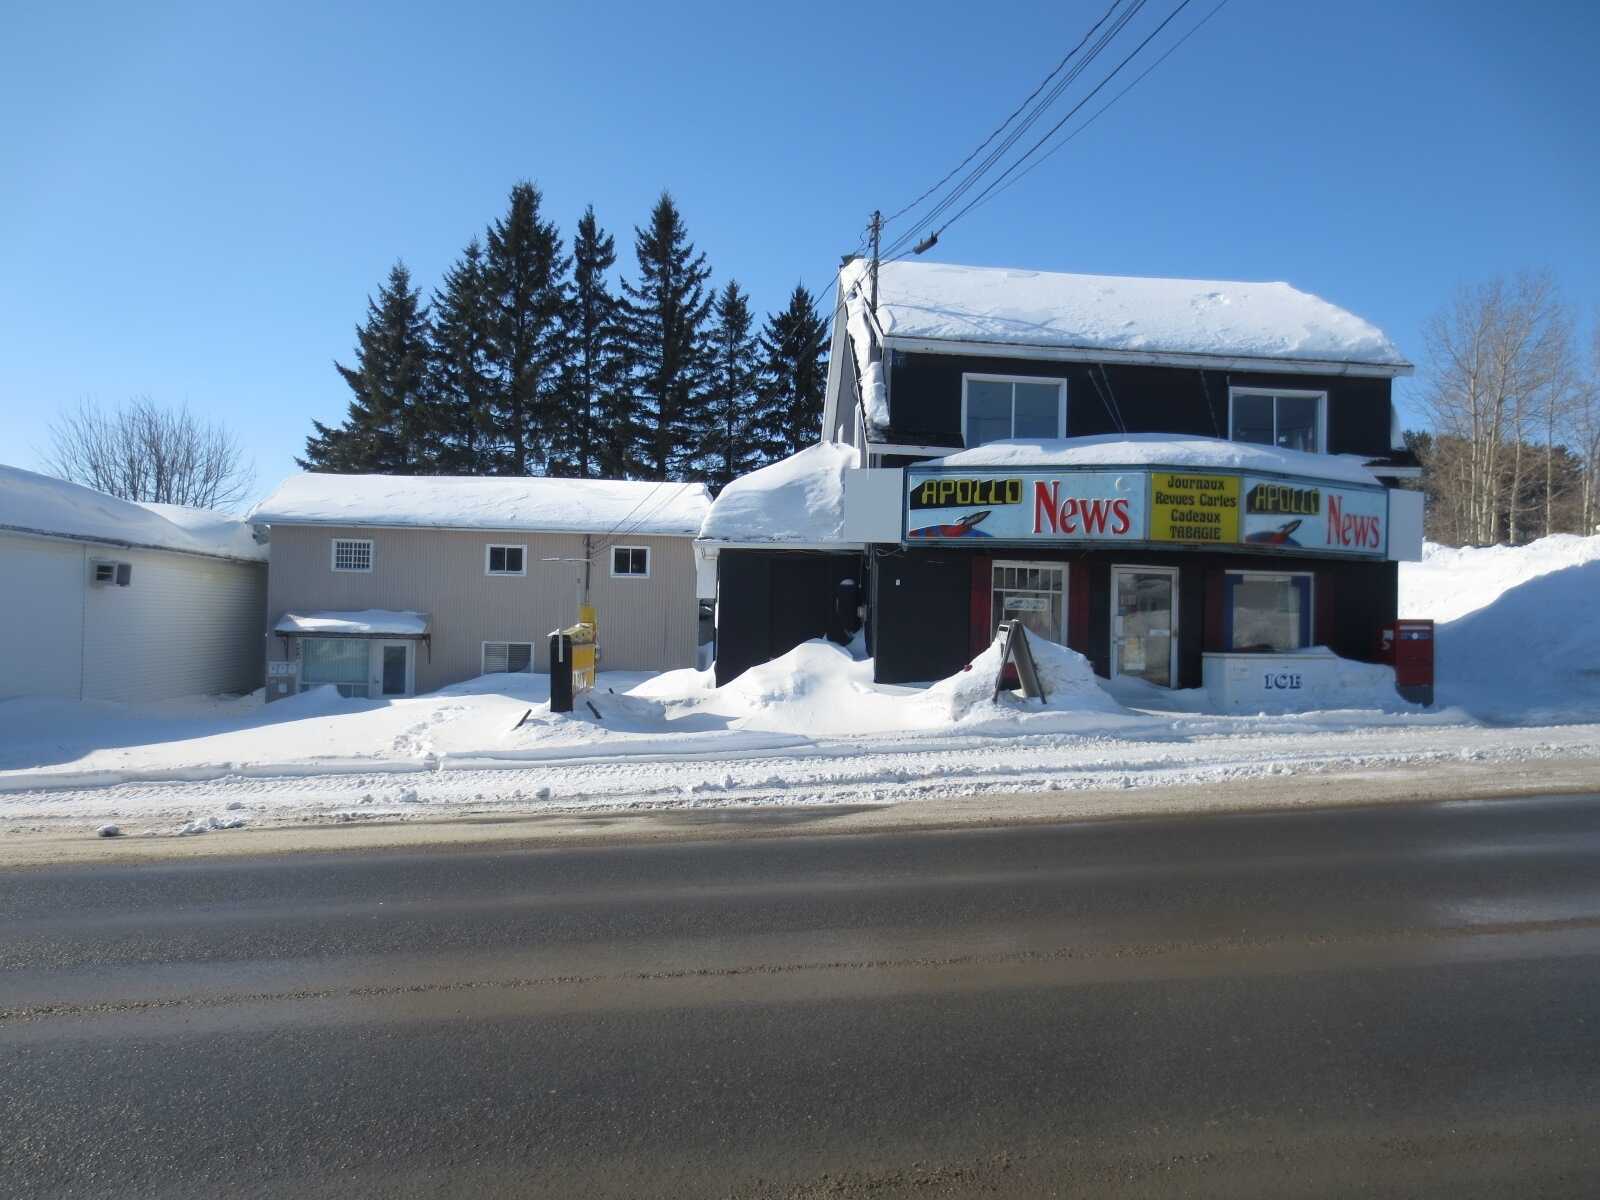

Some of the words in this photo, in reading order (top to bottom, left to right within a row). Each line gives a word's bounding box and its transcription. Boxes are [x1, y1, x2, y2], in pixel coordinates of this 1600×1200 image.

[1167, 475, 1225, 490] Journaux
[921, 479, 1023, 504] APOLLO
[1155, 491, 1195, 505] Revues
[1032, 480, 1130, 535] News
[1171, 508, 1221, 523] Cadeaux
[1327, 494, 1380, 549] News
[1169, 525, 1222, 540] TABAGIE
[1264, 673, 1303, 689] ICE
